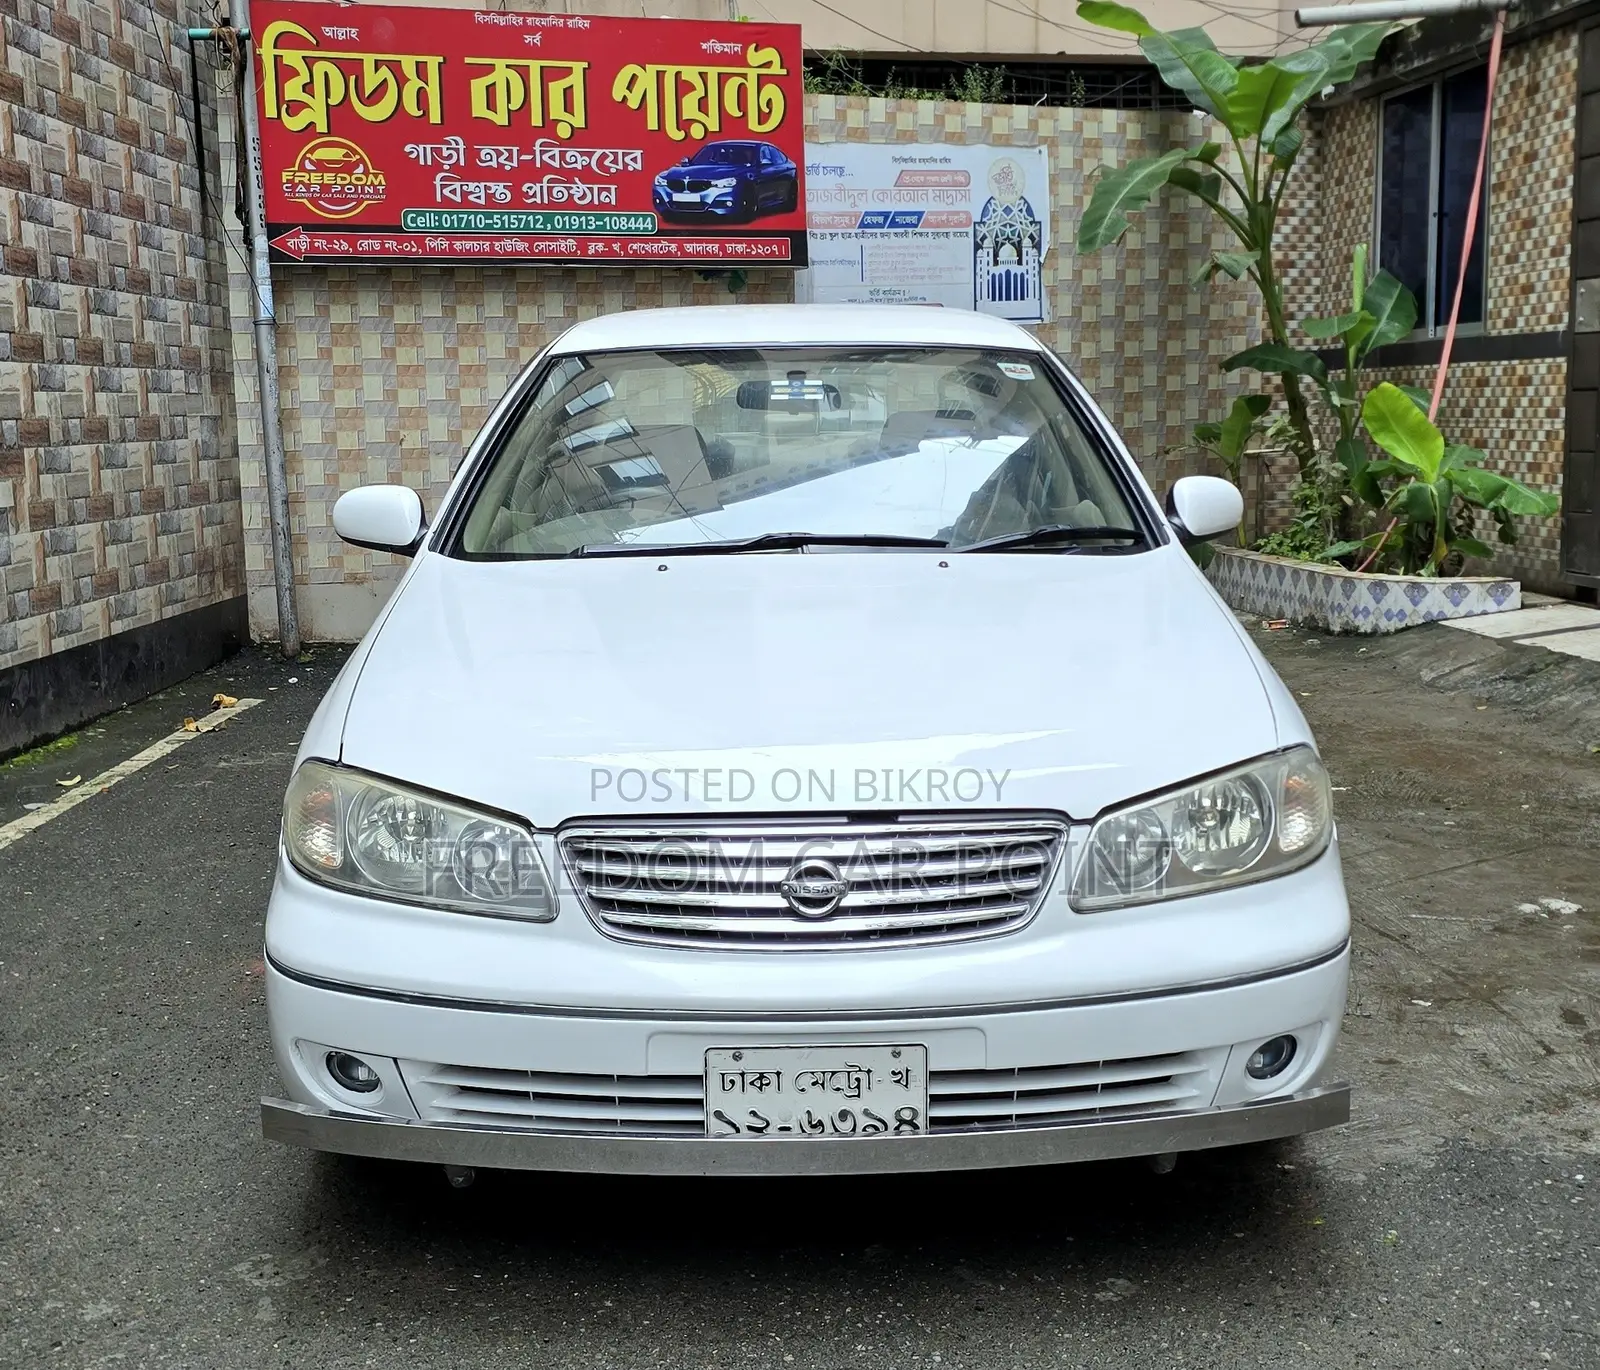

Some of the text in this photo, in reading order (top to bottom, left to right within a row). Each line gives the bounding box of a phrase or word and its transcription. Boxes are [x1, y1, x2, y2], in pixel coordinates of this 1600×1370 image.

[475, 12, 590, 30] বিসমিল্লাহির রাহমানির রাহিম
[321, 26, 360, 42] আল্লাহ
[523, 32, 542, 47] সর্ব
[700, 39, 743, 55] শক্তিমান
[256, 20, 788, 140] ফ্রিডম কার পয়েন্ট
[404, 136, 467, 170] গাড়ী
[282, 171, 386, 185] FREEDOM
[283, 183, 385, 194] CAR POINT
[433, 172, 618, 206] বিশ্বস্ত প্রতিষ্ঠান
[872, 188, 929, 204] কোরআন
[931, 188, 972, 206] মাদ্রাসা
[407, 214, 439, 227] Cell:
[554, 215, 653, 230] 01913-108444
[286, 235, 310, 252] বাড়ী
[314, 238, 352, 254] নং-২৯,
[357, 239, 381, 251] রোড
[384, 239, 422, 254] নং-০১,
[425, 237, 450, 252] পিসি
[452, 239, 490, 252] কালচার
[493, 238, 530, 253] হাউজিং
[533, 239, 581, 255] সোসাইটি,
[628, 240, 681, 256] শেখেরটেক,
[683, 242, 722, 257] আদাবর,
[788, 885, 840, 894] NISSAN
[719, 1070, 783, 1093] ঢাকা
